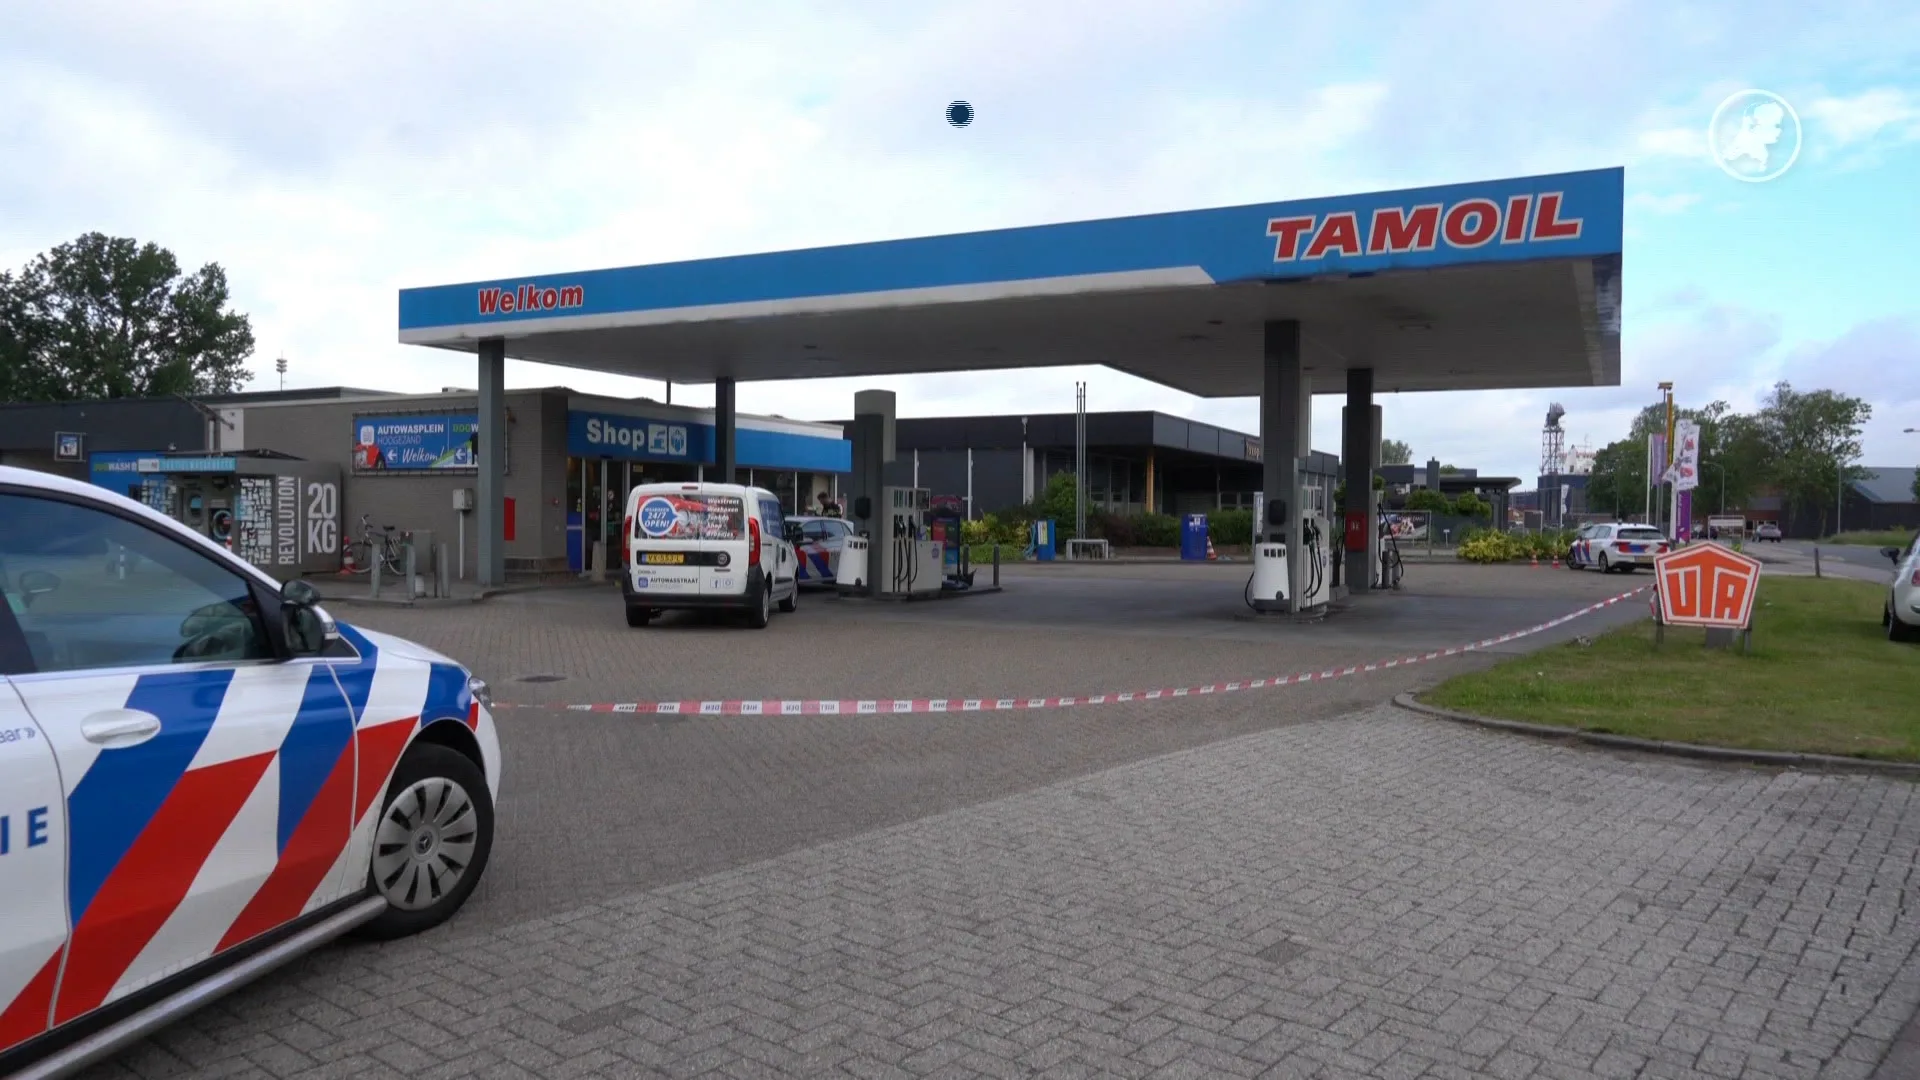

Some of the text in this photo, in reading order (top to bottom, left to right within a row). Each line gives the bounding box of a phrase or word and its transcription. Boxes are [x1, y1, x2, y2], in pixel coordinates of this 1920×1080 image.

[1266, 191, 1583, 262] TAMOIL
[478, 284, 584, 315] Welkom
[378, 424, 444, 435] AUTOWASPLEIN
[378, 435, 421, 445] HOOGEZAND
[587, 419, 645, 451] Shop
[308, 483, 336, 519] 20
[278, 476, 295, 564] REVOLUTION
[645, 520, 669, 528] OPEN!
[308, 520, 336, 553] KG
[1664, 551, 1752, 620] UTA
